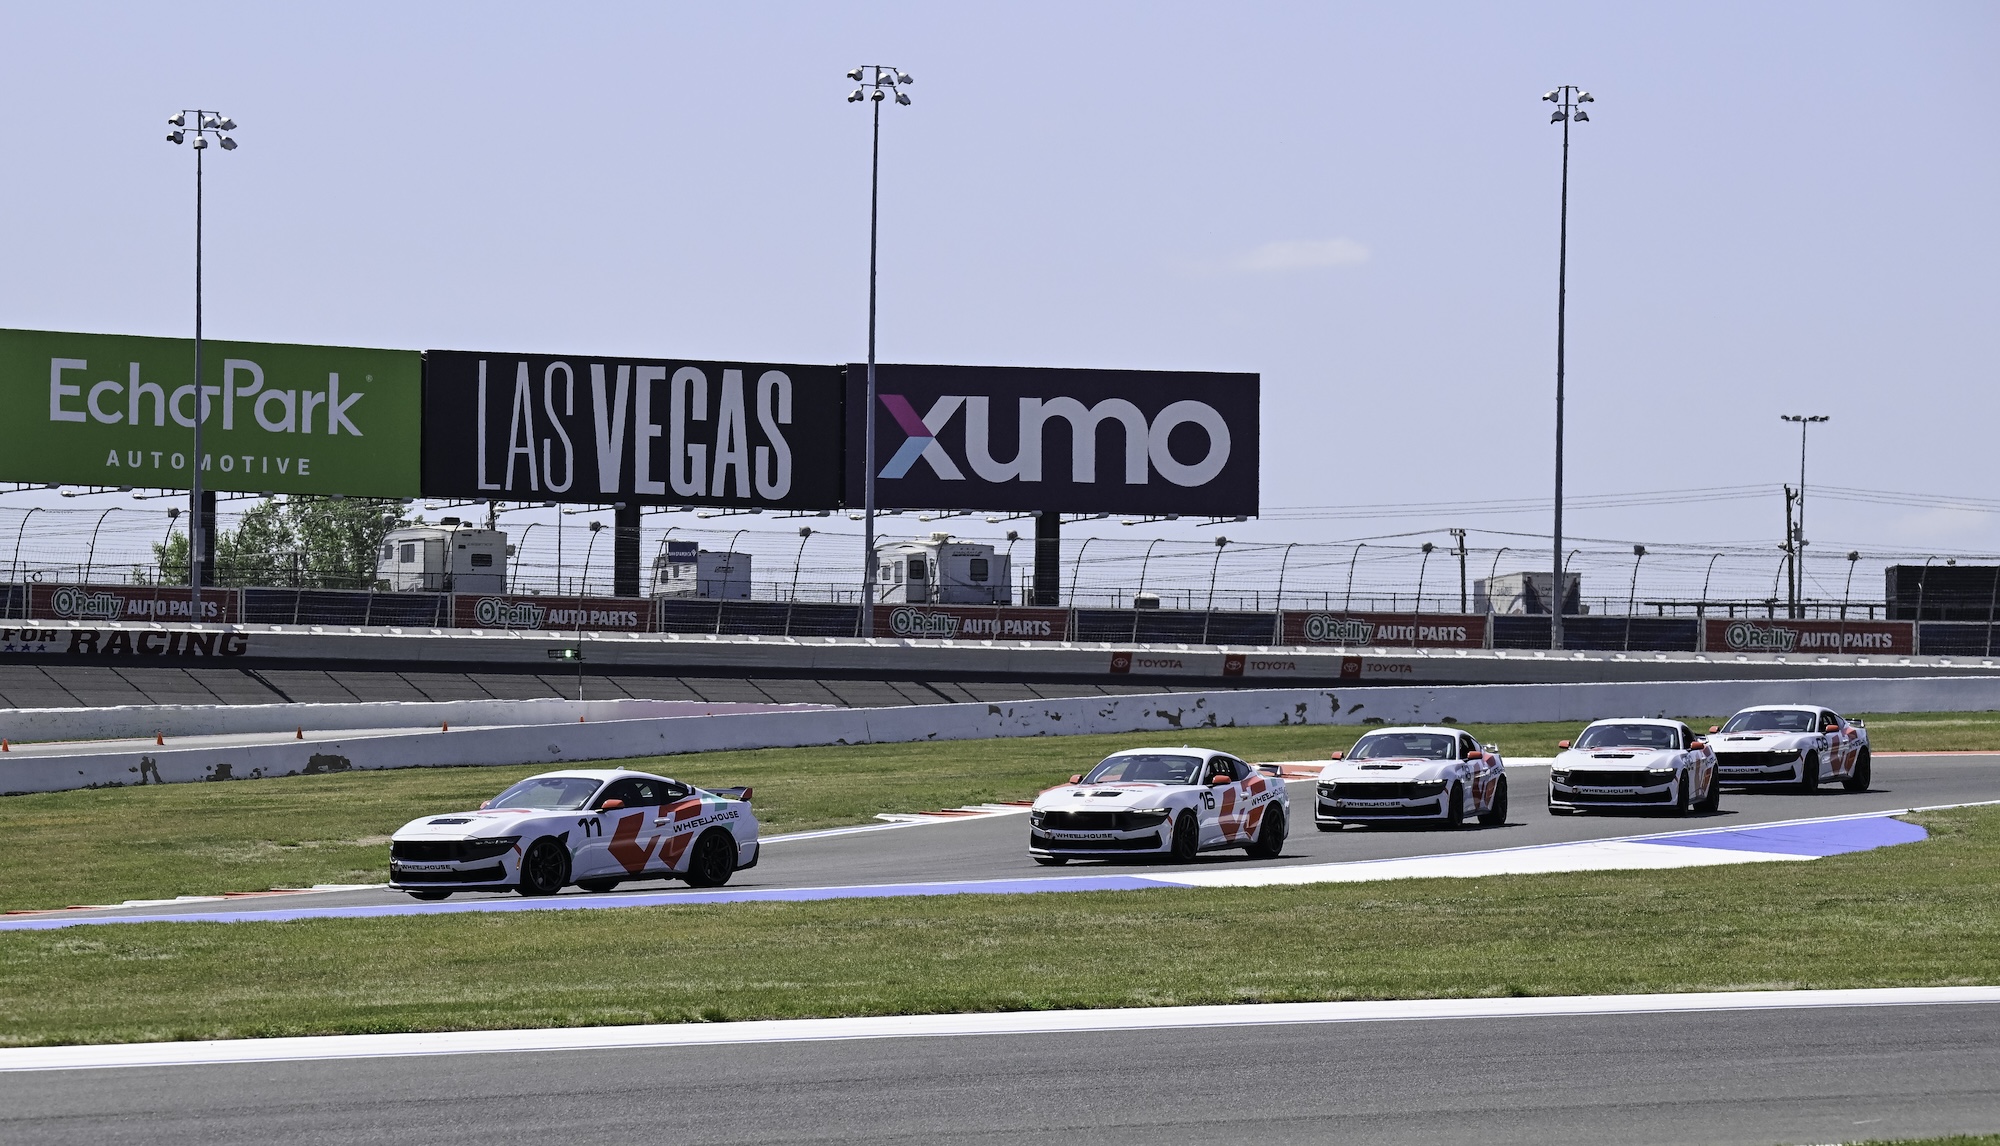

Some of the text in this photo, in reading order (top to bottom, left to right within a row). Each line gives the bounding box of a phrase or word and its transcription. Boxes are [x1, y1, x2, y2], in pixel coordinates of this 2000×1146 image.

[49, 357, 364, 437] EchoPark
[477, 359, 793, 500] LAS VEGAS
[877, 393, 1232, 488] xumo
[106, 449, 310, 476] AUTOMOTIVE
[52, 587, 218, 619] O'Reilly AUTO PATS
[475, 598, 637, 629] O'Reilly AUTO PARTS
[890, 607, 1051, 638] O'Reilly AUTO PARTS
[1304, 614, 1467, 646] O'Reilly AUTO PARTS
[1, 629, 248, 656] FOR RACING
[1726, 622, 1892, 653] O'Reilly AUTO PARTS
[1137, 658, 1183, 669] TOYOTA
[1250, 660, 1296, 671] TOYOTA
[1366, 663, 1412, 673] TOYOTA
[1199, 791, 1216, 810] 16
[577, 817, 603, 838] 11
[673, 810, 740, 833] WHEELHOUSE
